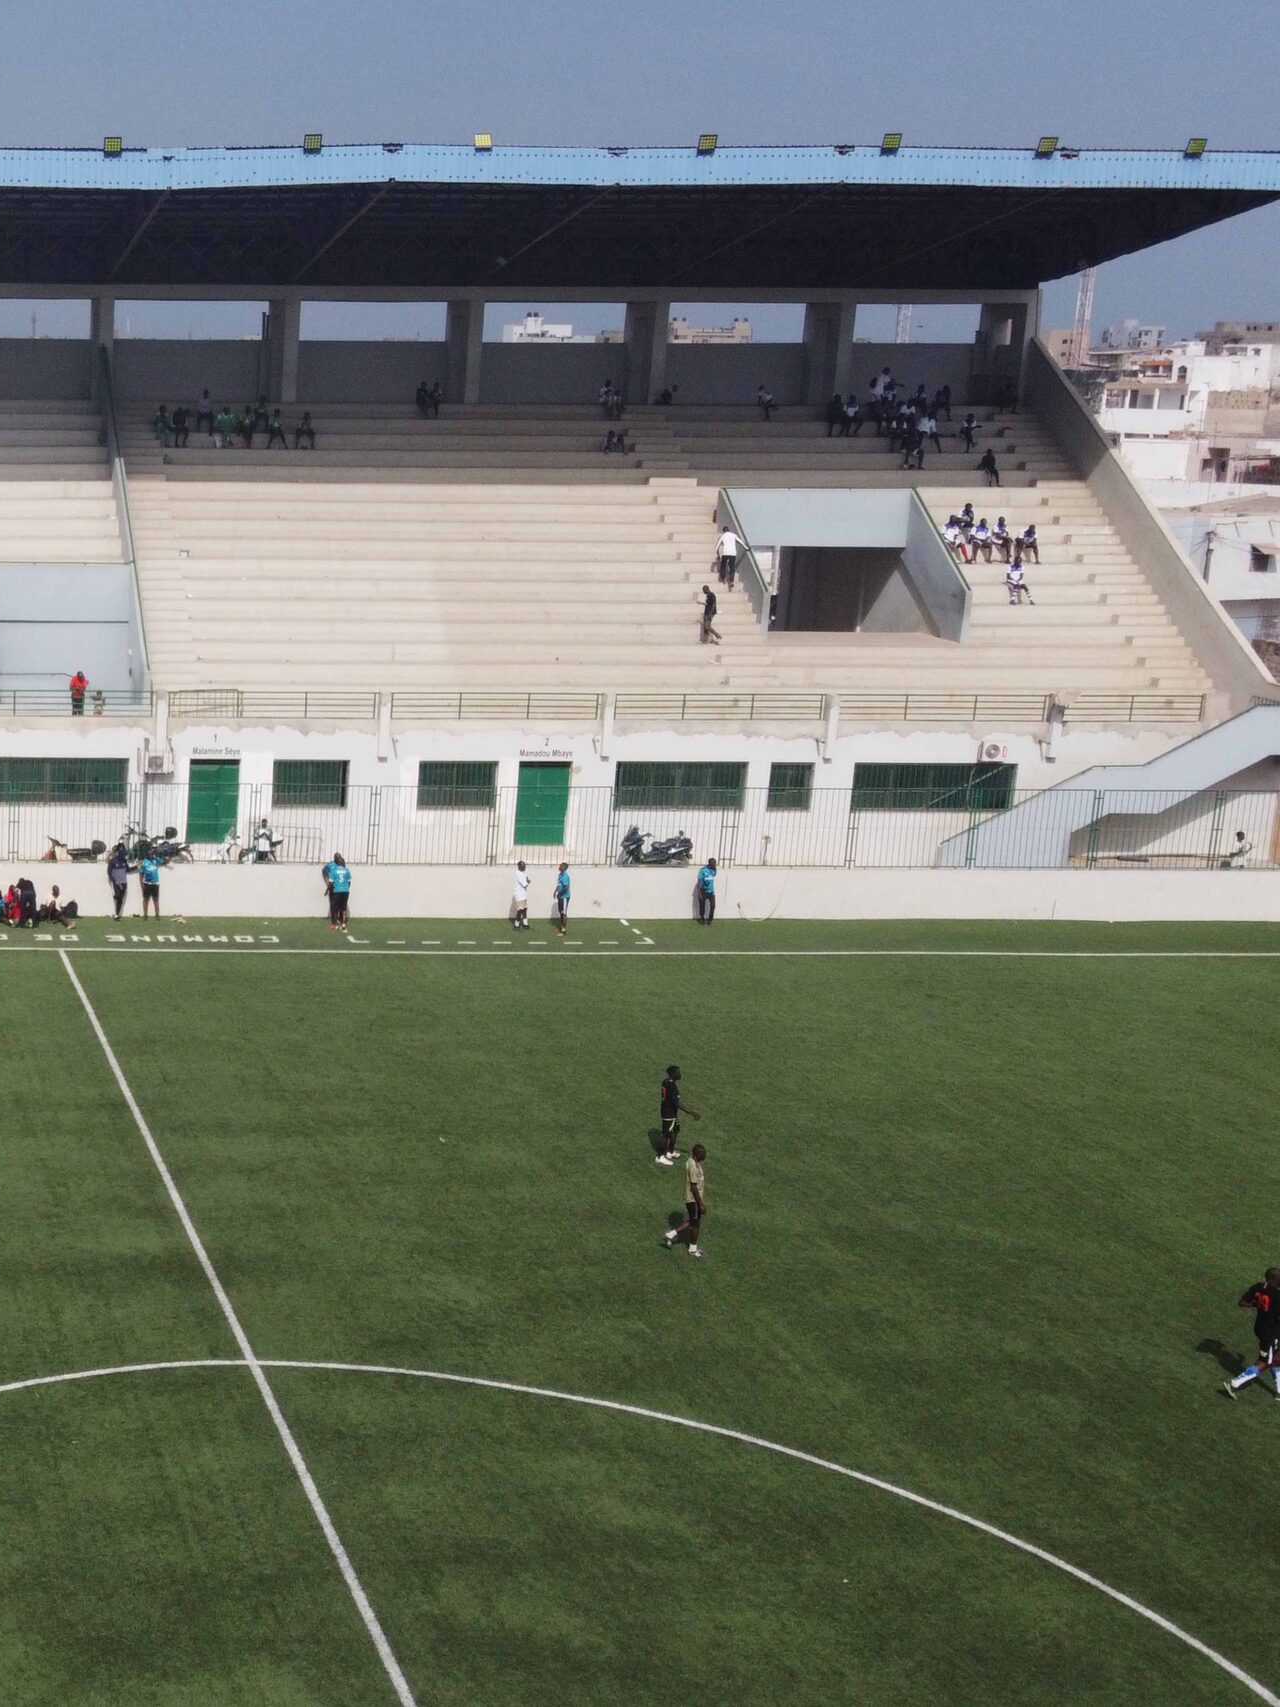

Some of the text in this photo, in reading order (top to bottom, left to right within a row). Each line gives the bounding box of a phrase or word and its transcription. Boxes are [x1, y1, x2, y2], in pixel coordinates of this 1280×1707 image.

[544, 737, 551, 747] 2
[519, 749, 573, 759] Mamadou Mbaye
[33, 933, 79, 941] DE
[105, 934, 280, 943] COMMUNE
